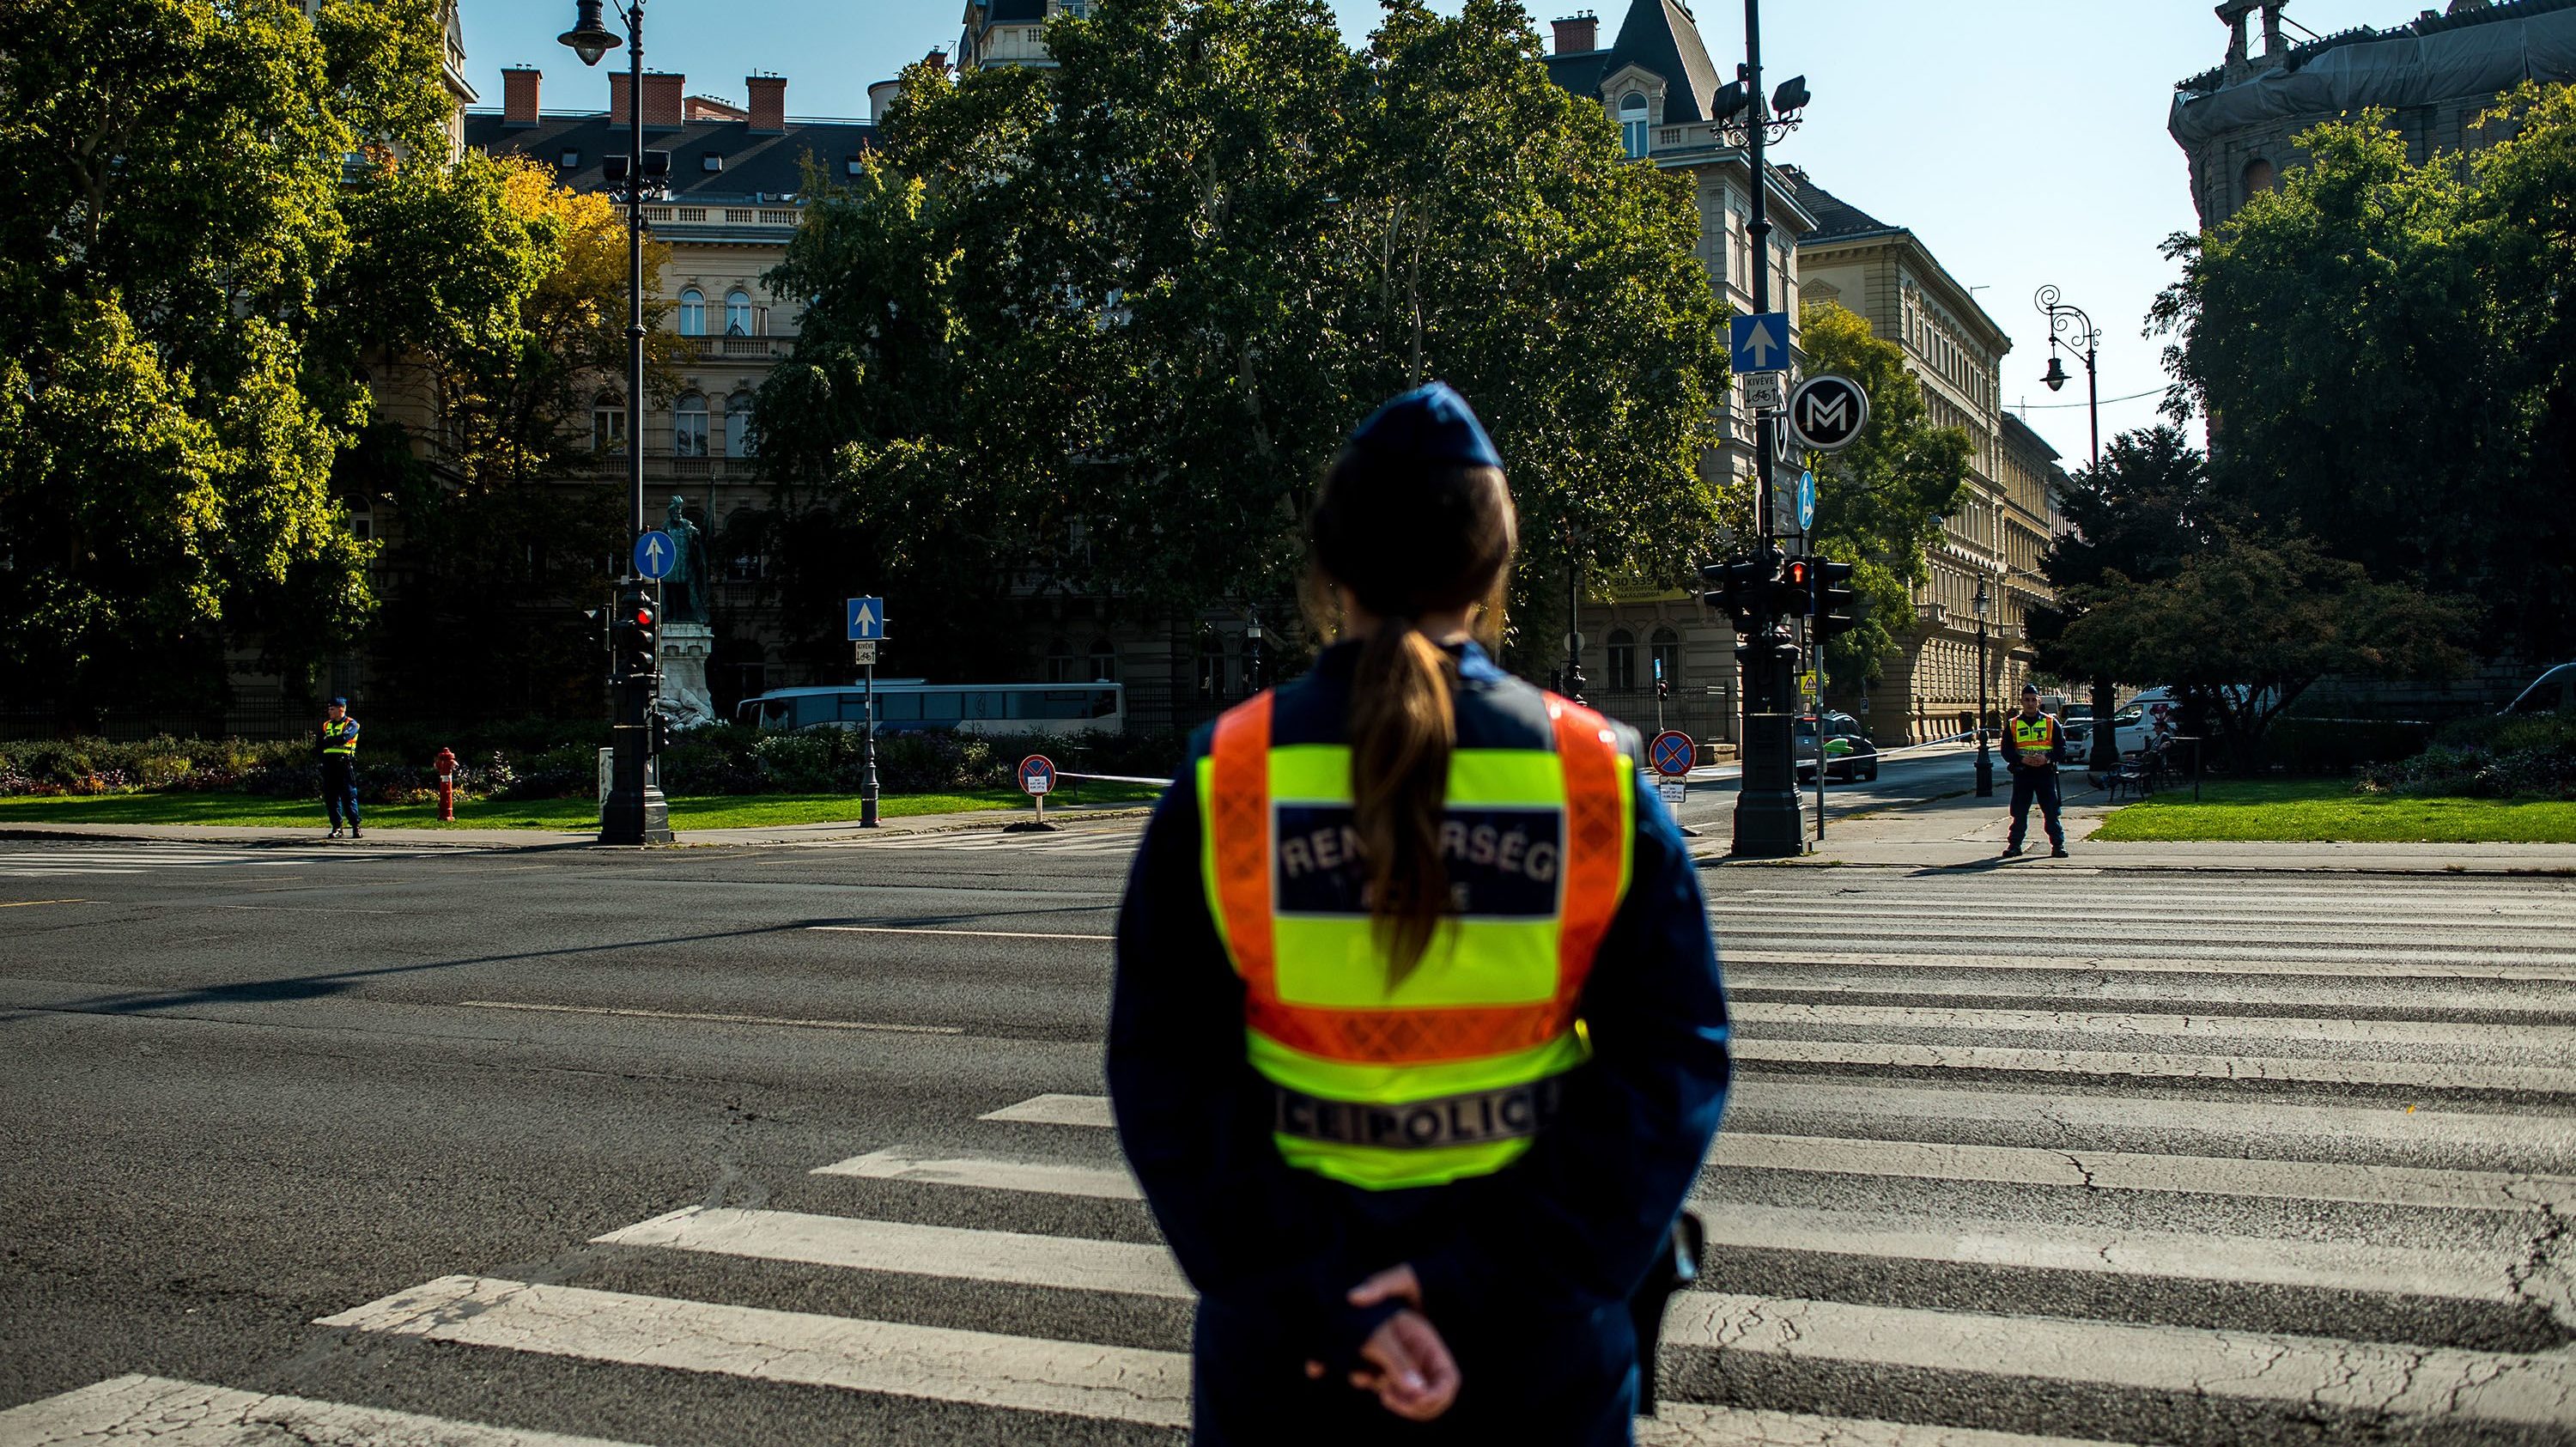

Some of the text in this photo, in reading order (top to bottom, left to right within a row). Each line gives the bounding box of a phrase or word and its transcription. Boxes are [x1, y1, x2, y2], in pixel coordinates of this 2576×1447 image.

[1747, 375, 1774, 386] KIVÉVE
[1631, 576, 1654, 586] 535
[1280, 820, 1558, 884] RENRSÉG
[1367, 1089, 1546, 1146] POLIC
